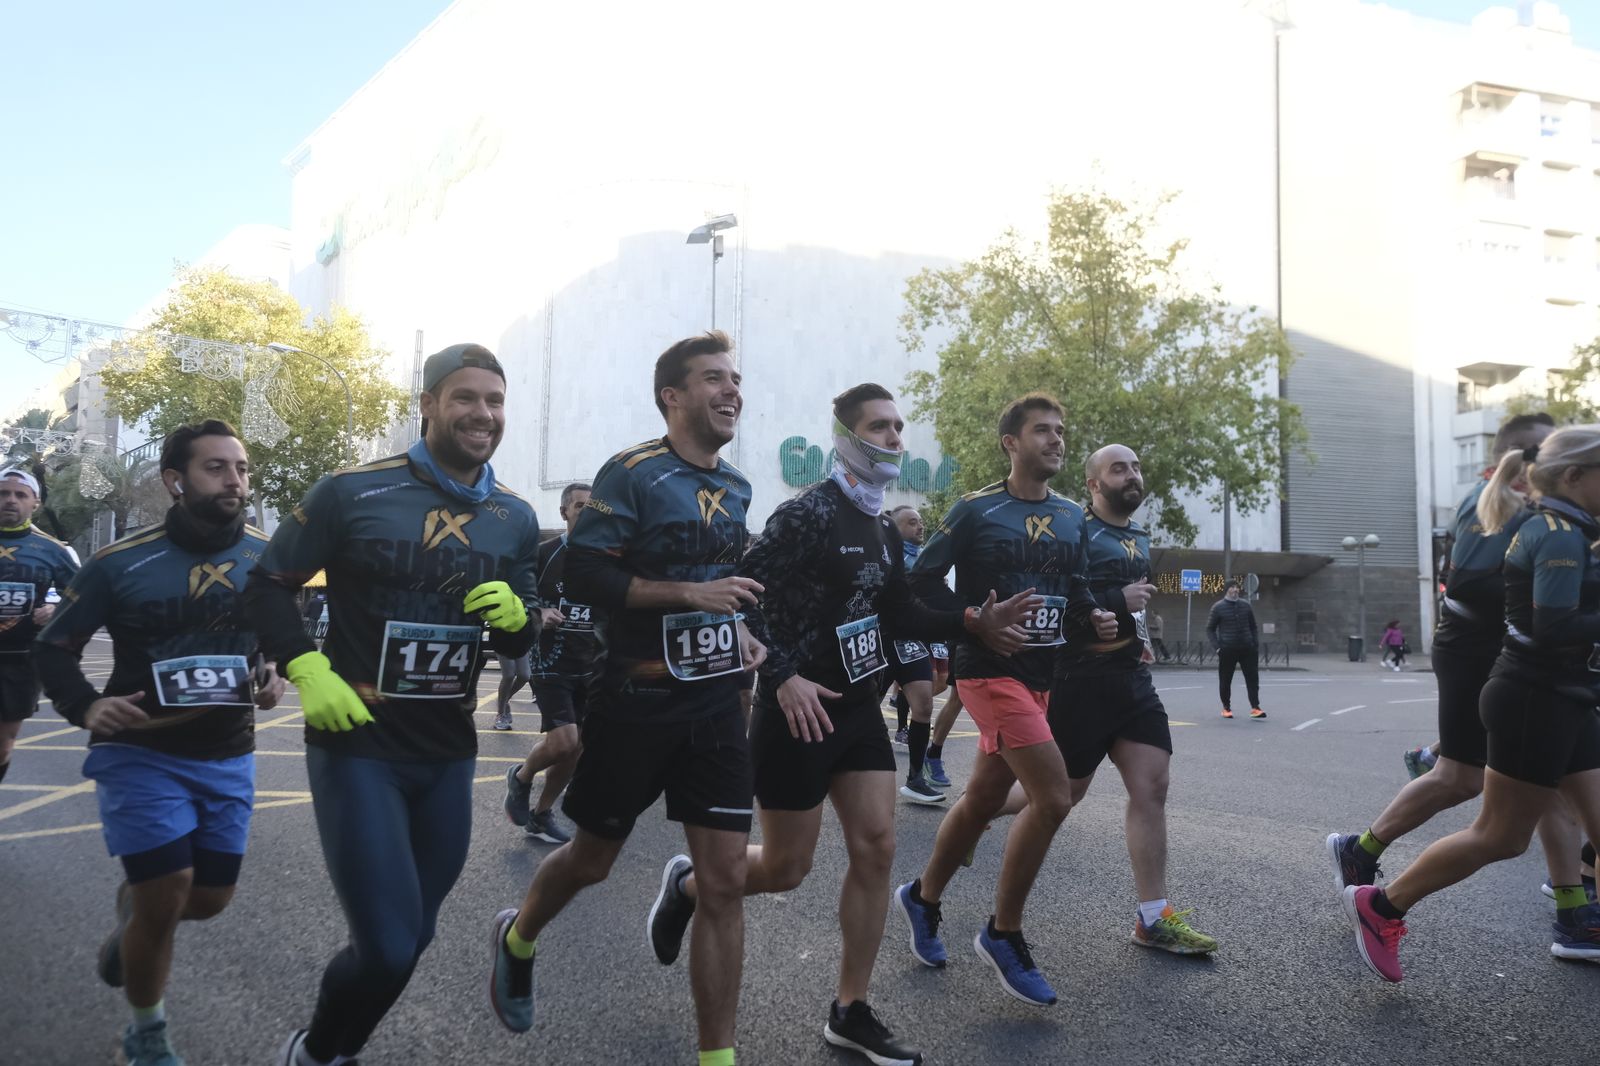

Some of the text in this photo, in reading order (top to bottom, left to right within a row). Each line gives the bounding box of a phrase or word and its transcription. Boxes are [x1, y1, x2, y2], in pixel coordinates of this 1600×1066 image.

[485, 499, 510, 521] SIG
[585, 497, 613, 516] estión
[696, 487, 731, 528] IX
[423, 505, 478, 552] IX
[1024, 513, 1057, 545] IX
[188, 560, 237, 601] IX
[1184, 576, 1200, 585] TAXI
[569, 607, 590, 622] 54
[677, 623, 733, 658] 190
[847, 629, 877, 660] 188
[399, 641, 469, 673] 174
[169, 667, 238, 689] 191
